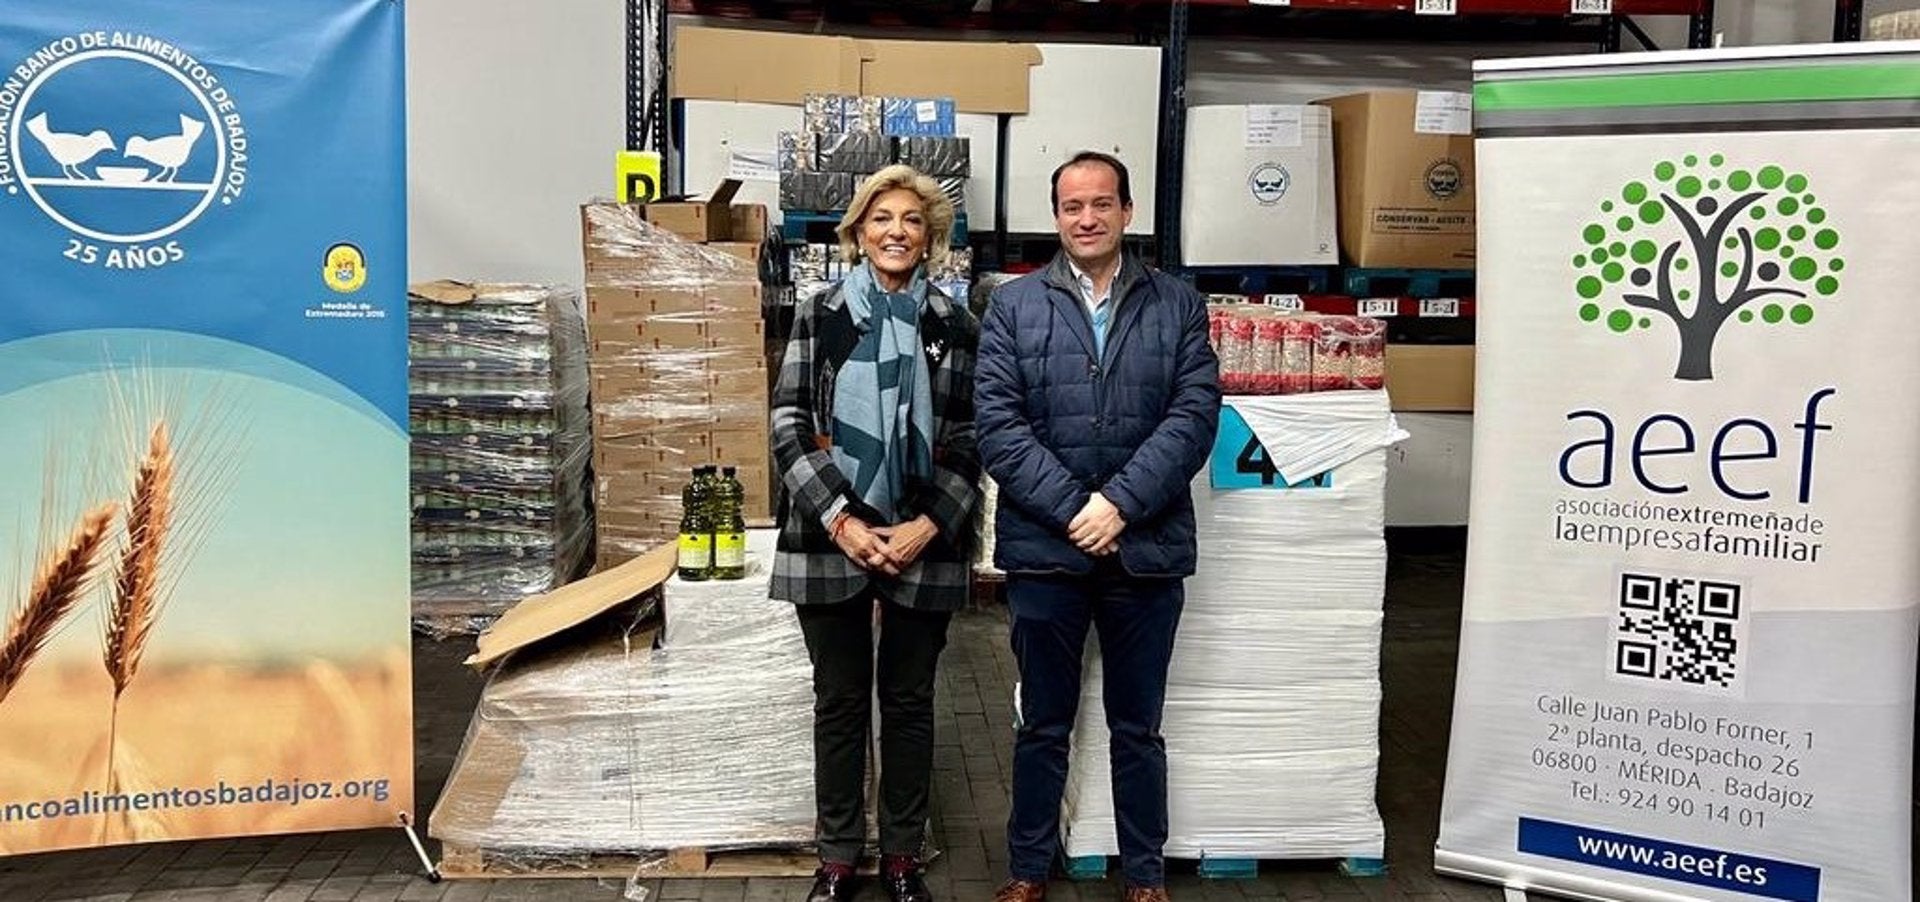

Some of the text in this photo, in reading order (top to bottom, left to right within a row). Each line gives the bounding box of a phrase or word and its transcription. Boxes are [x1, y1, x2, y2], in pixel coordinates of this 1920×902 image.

[15, 37, 78, 82] BANCO
[80, 31, 108, 49] DE
[111, 31, 218, 90] ALIMENTOS
[210, 87, 235, 114] DE
[222, 113, 248, 197] BADAJOZ
[626, 173, 655, 204] D
[63, 239, 184, 269] 25 AÑOS
[1559, 387, 1836, 505] aeef
[1555, 498, 1824, 536] asociaciónextremeñade
[1556, 515, 1822, 563] laempresafamiliar
[1537, 695, 1813, 751] Calle Juan Pablo Forner, 1
[1576, 726, 1647, 757] planta,
[1656, 736, 1762, 771] despacho
[1771, 755, 1800, 777] 26
[0, 777, 390, 822] ncoalimentosbadajoz.org
[1532, 748, 1814, 809] 06800 MÉRIDA Badajoz
[1572, 780, 1764, 829] Tel.: 924 90 14 01
[1577, 835, 1768, 886] www.aeef.es
